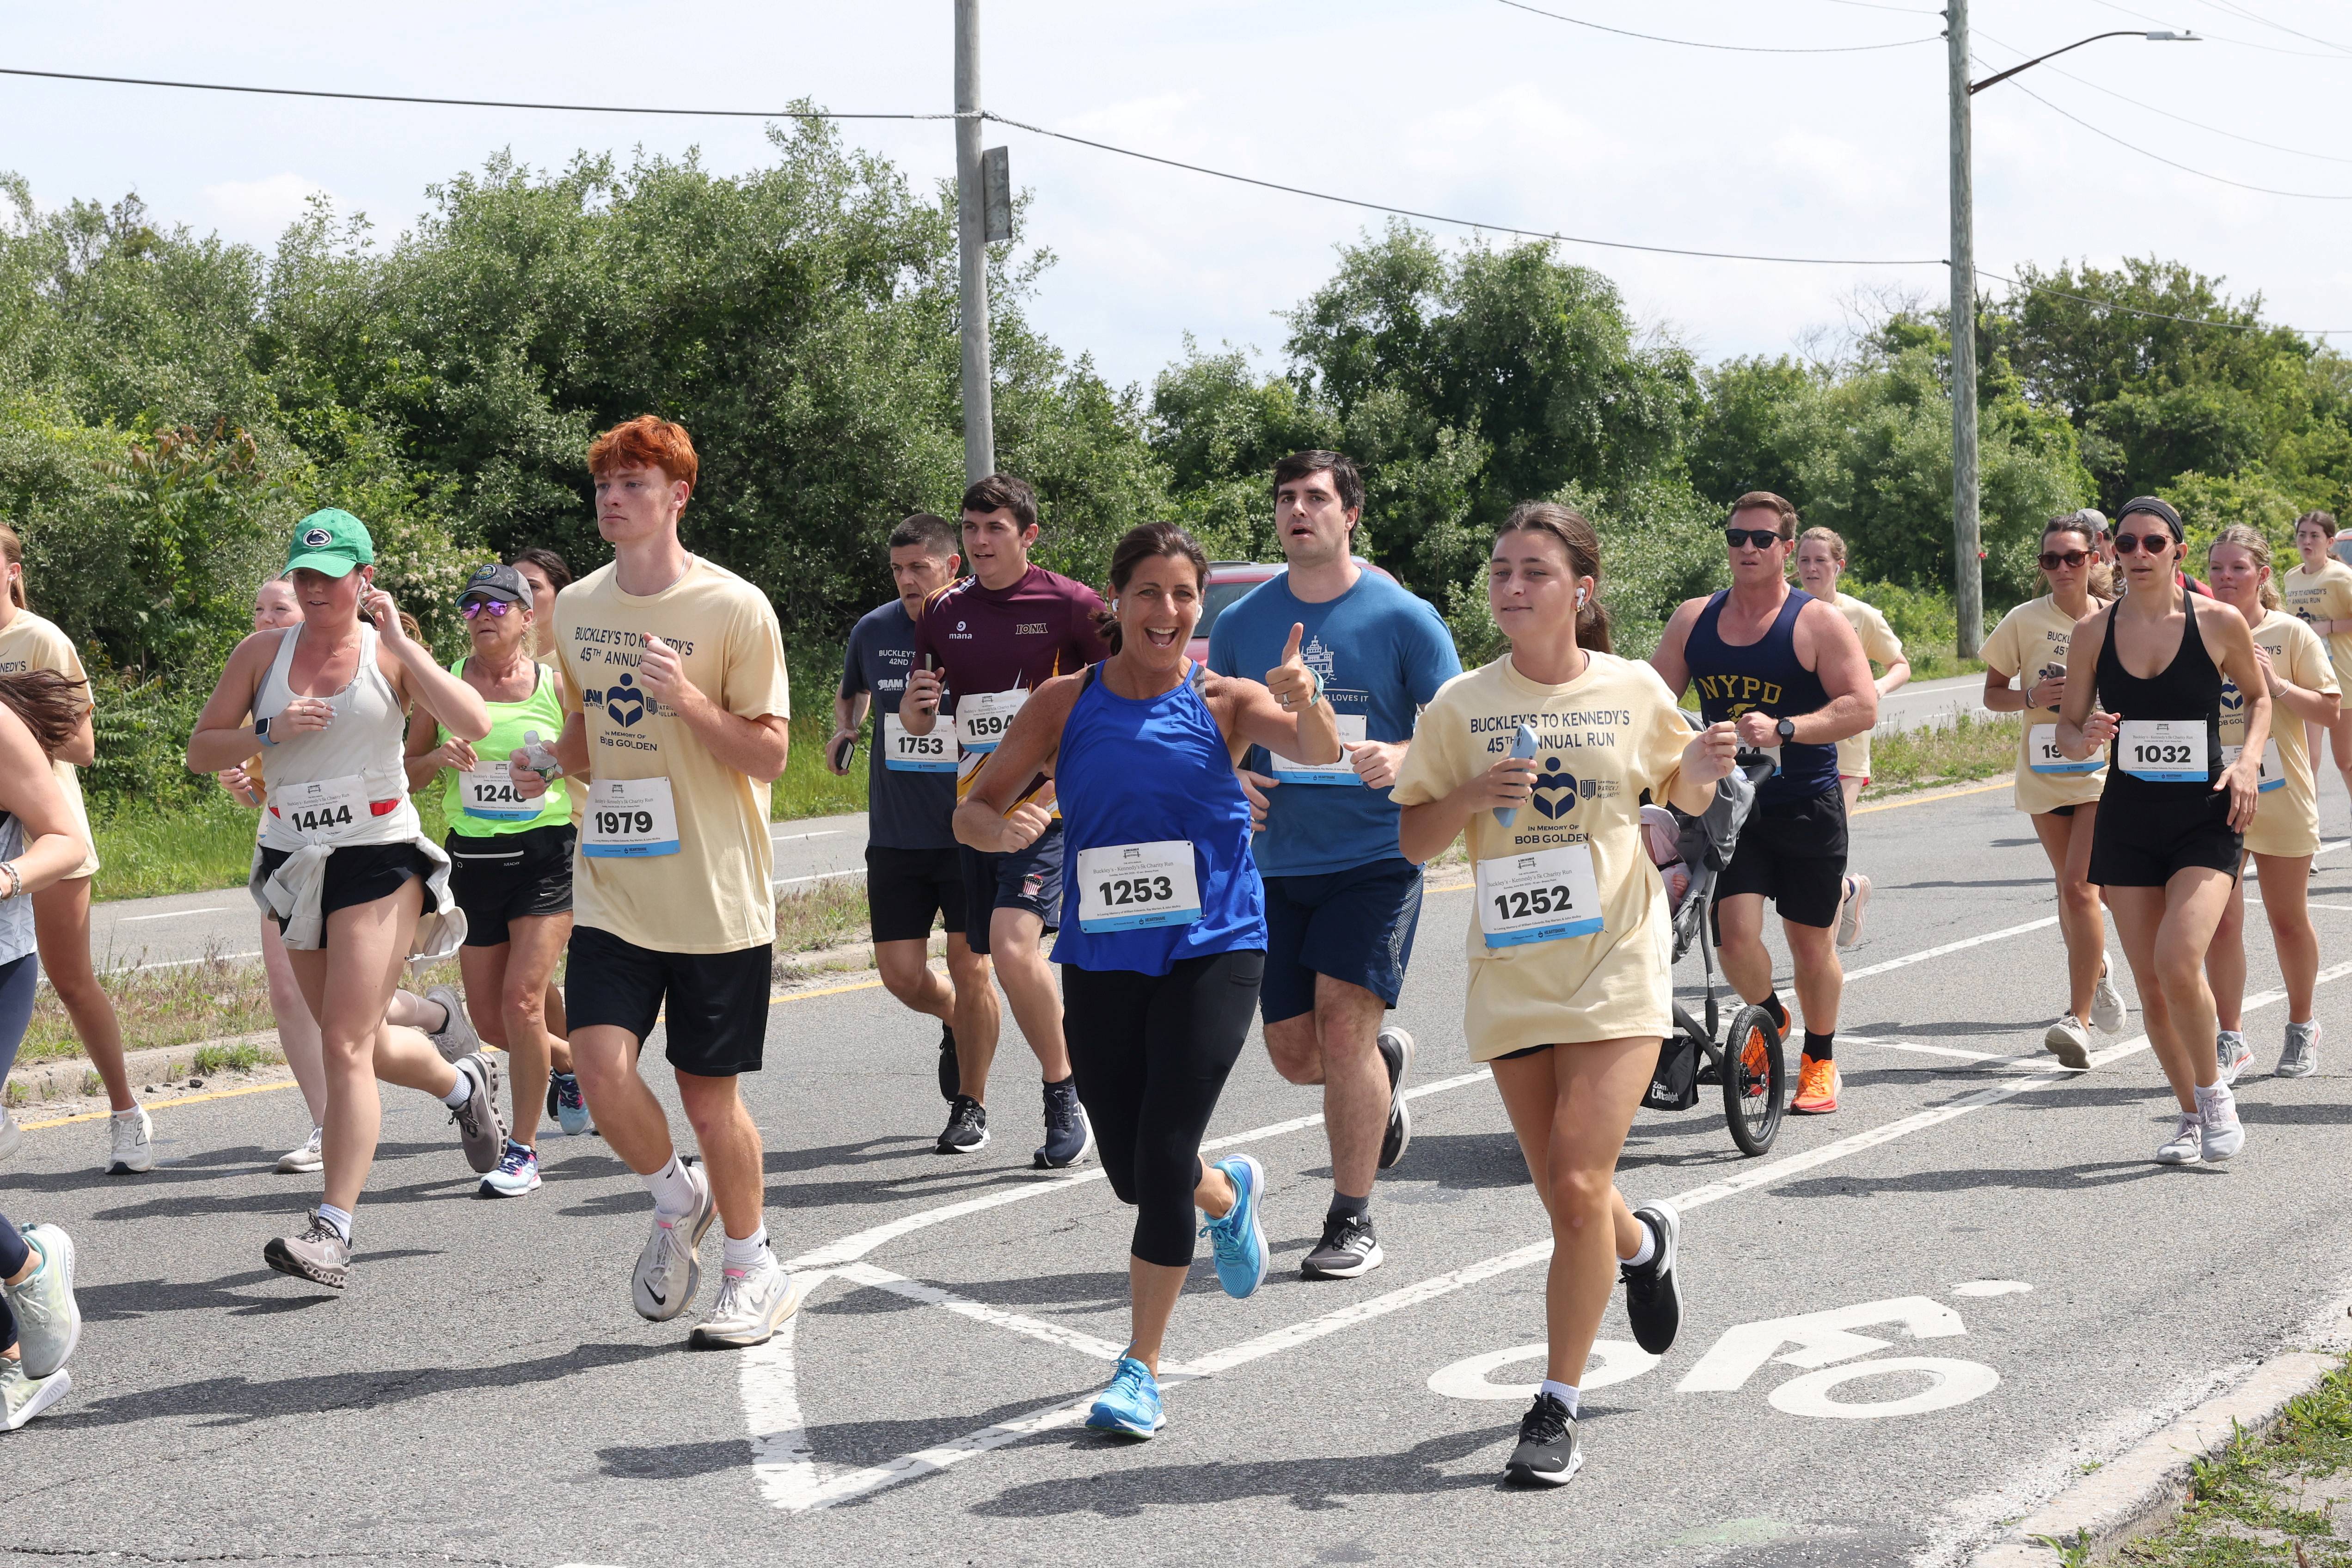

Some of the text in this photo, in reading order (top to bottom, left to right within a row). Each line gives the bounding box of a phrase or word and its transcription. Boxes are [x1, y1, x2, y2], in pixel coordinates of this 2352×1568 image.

[1016, 623, 1048, 635] IONA
[2047, 631, 2070, 643] BUCKL
[575, 627, 694, 655] BUCKLEY'S TO KEDY'S
[2053, 645, 2068, 655] 45T
[580, 647, 643, 667] 45TH ANNUA
[1698, 675, 1782, 704] NYPD
[1470, 710, 1629, 733] BUCKLEY'S TO KENNEDY'S
[600, 736, 657, 751] BOB GOLDEN
[898, 737, 943, 754] 1753
[1538, 734, 1581, 749] NNUAL
[1587, 732, 1614, 747] RUN
[2042, 745, 2062, 758] 19
[2135, 745, 2191, 763] 1032
[292, 805, 353, 832] 1444
[595, 811, 653, 833] 1979
[1515, 833, 1589, 844] BOB GOLDEN
[1099, 876, 1173, 906] 1253
[1494, 885, 1573, 919] 1252
